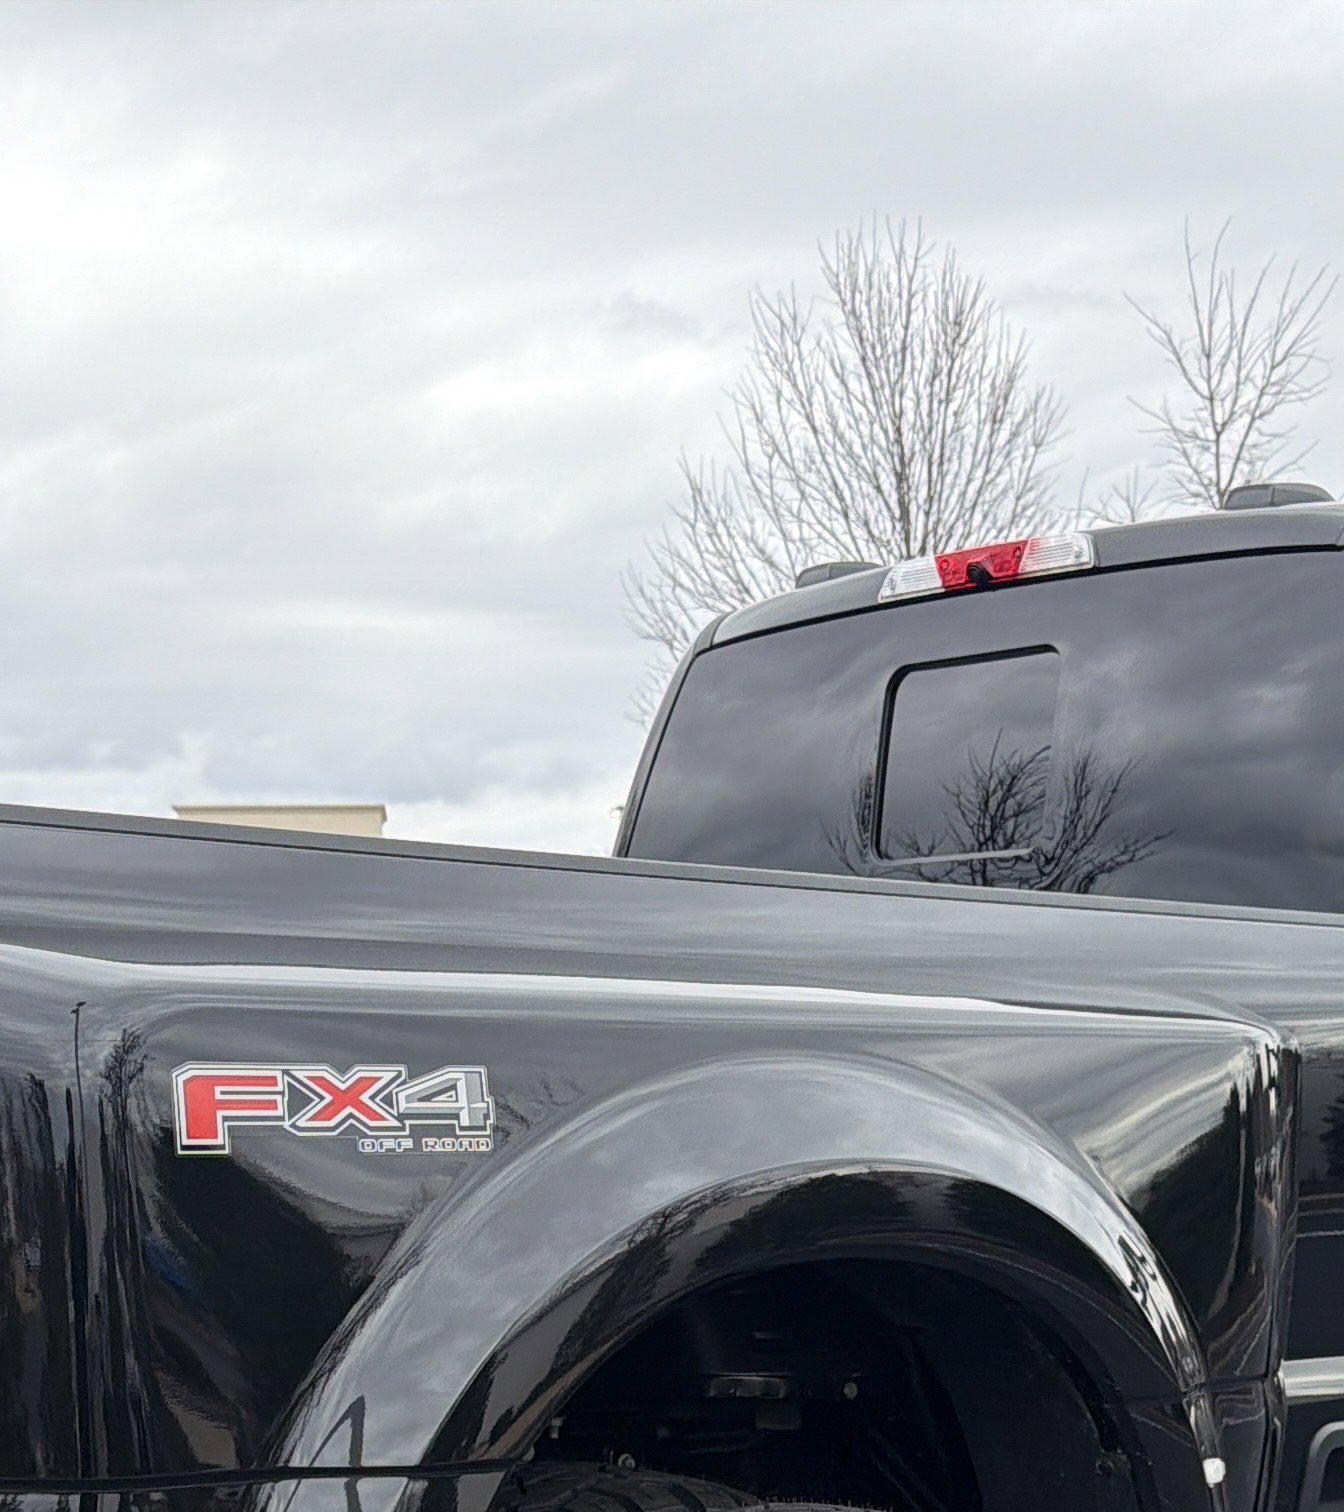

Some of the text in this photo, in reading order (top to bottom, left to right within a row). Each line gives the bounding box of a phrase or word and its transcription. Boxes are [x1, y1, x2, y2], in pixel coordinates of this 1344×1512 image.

[171, 1061, 496, 1157] FX4
[359, 1137, 493, 1152] OFF ROAD
